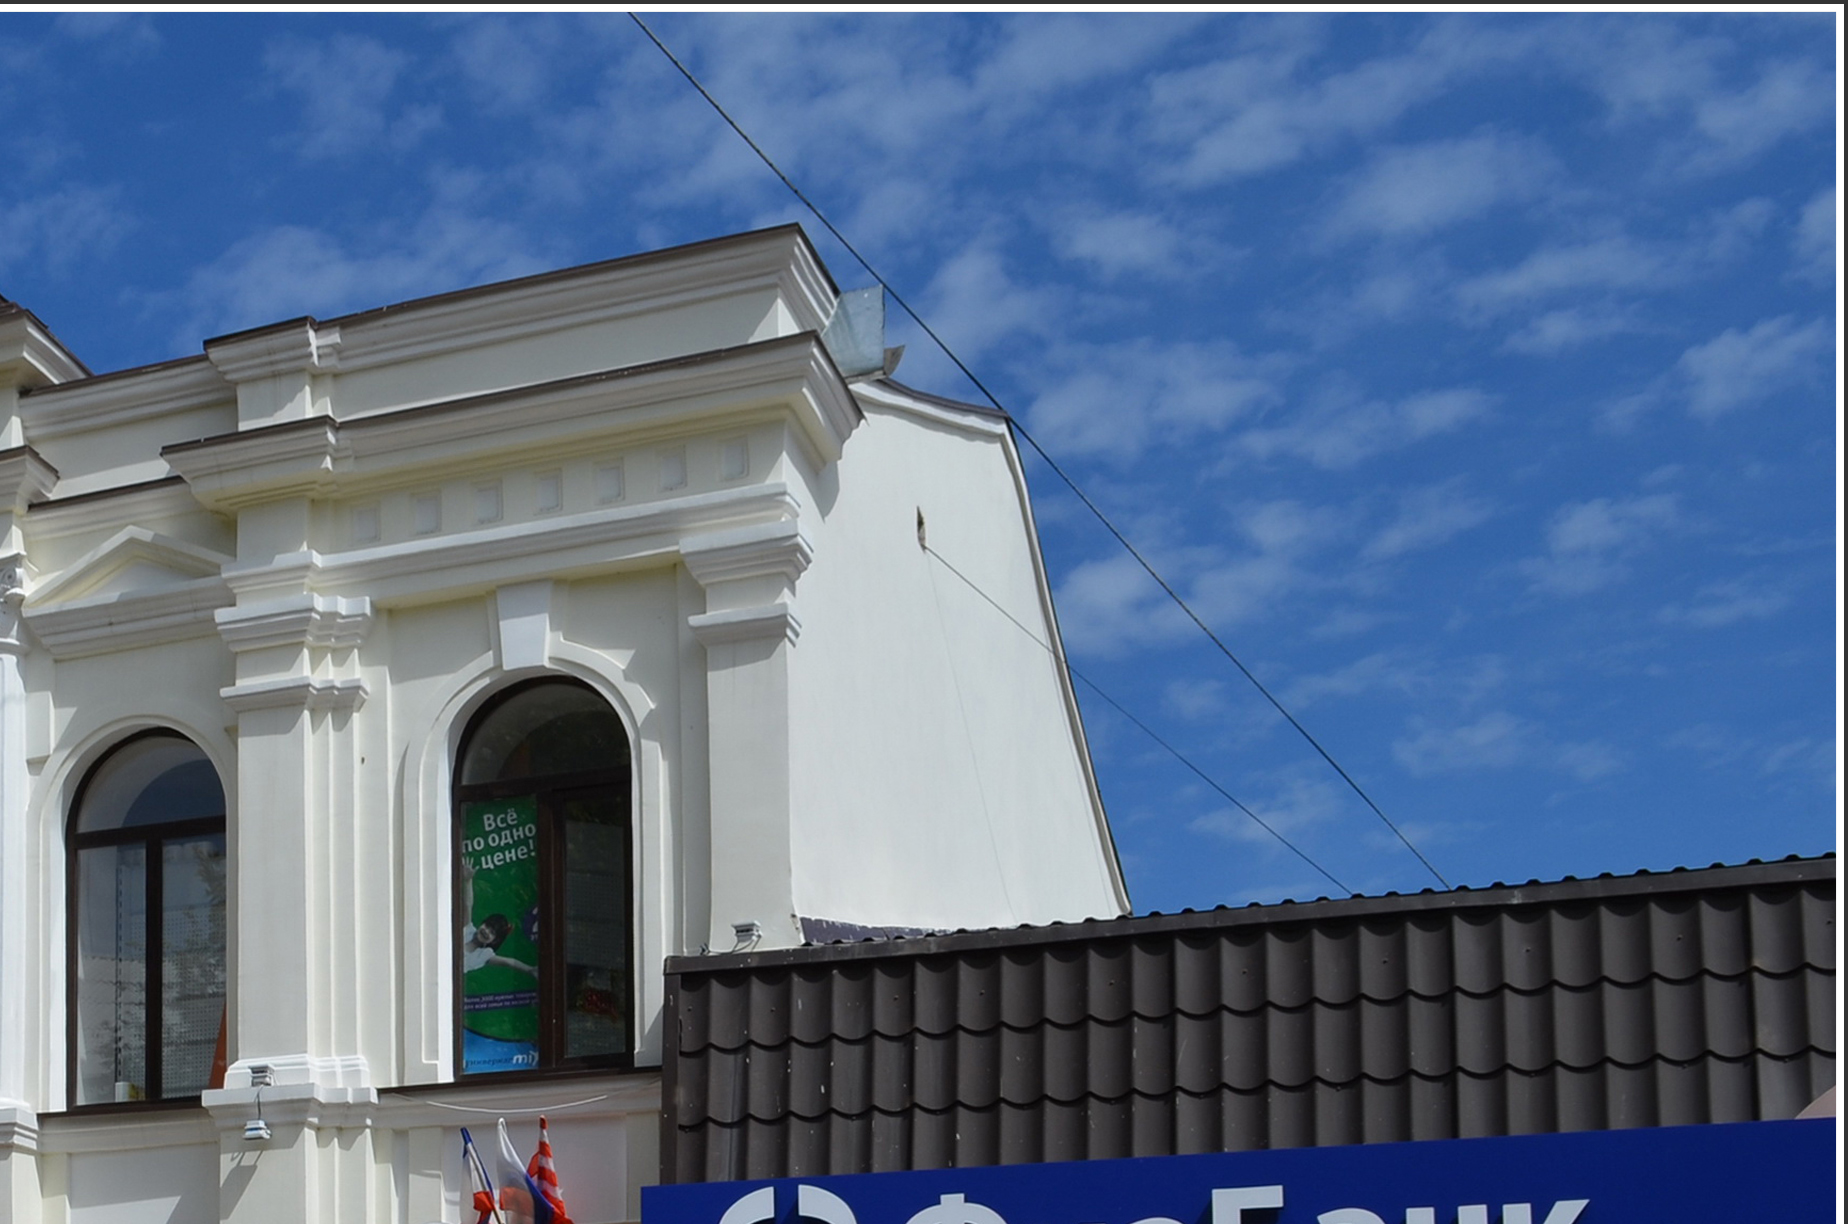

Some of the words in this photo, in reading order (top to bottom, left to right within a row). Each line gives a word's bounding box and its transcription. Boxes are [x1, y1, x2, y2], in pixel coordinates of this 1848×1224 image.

[483, 808, 518, 831] Всё
[462, 837, 484, 853] по
[481, 839, 536, 869] цене!
